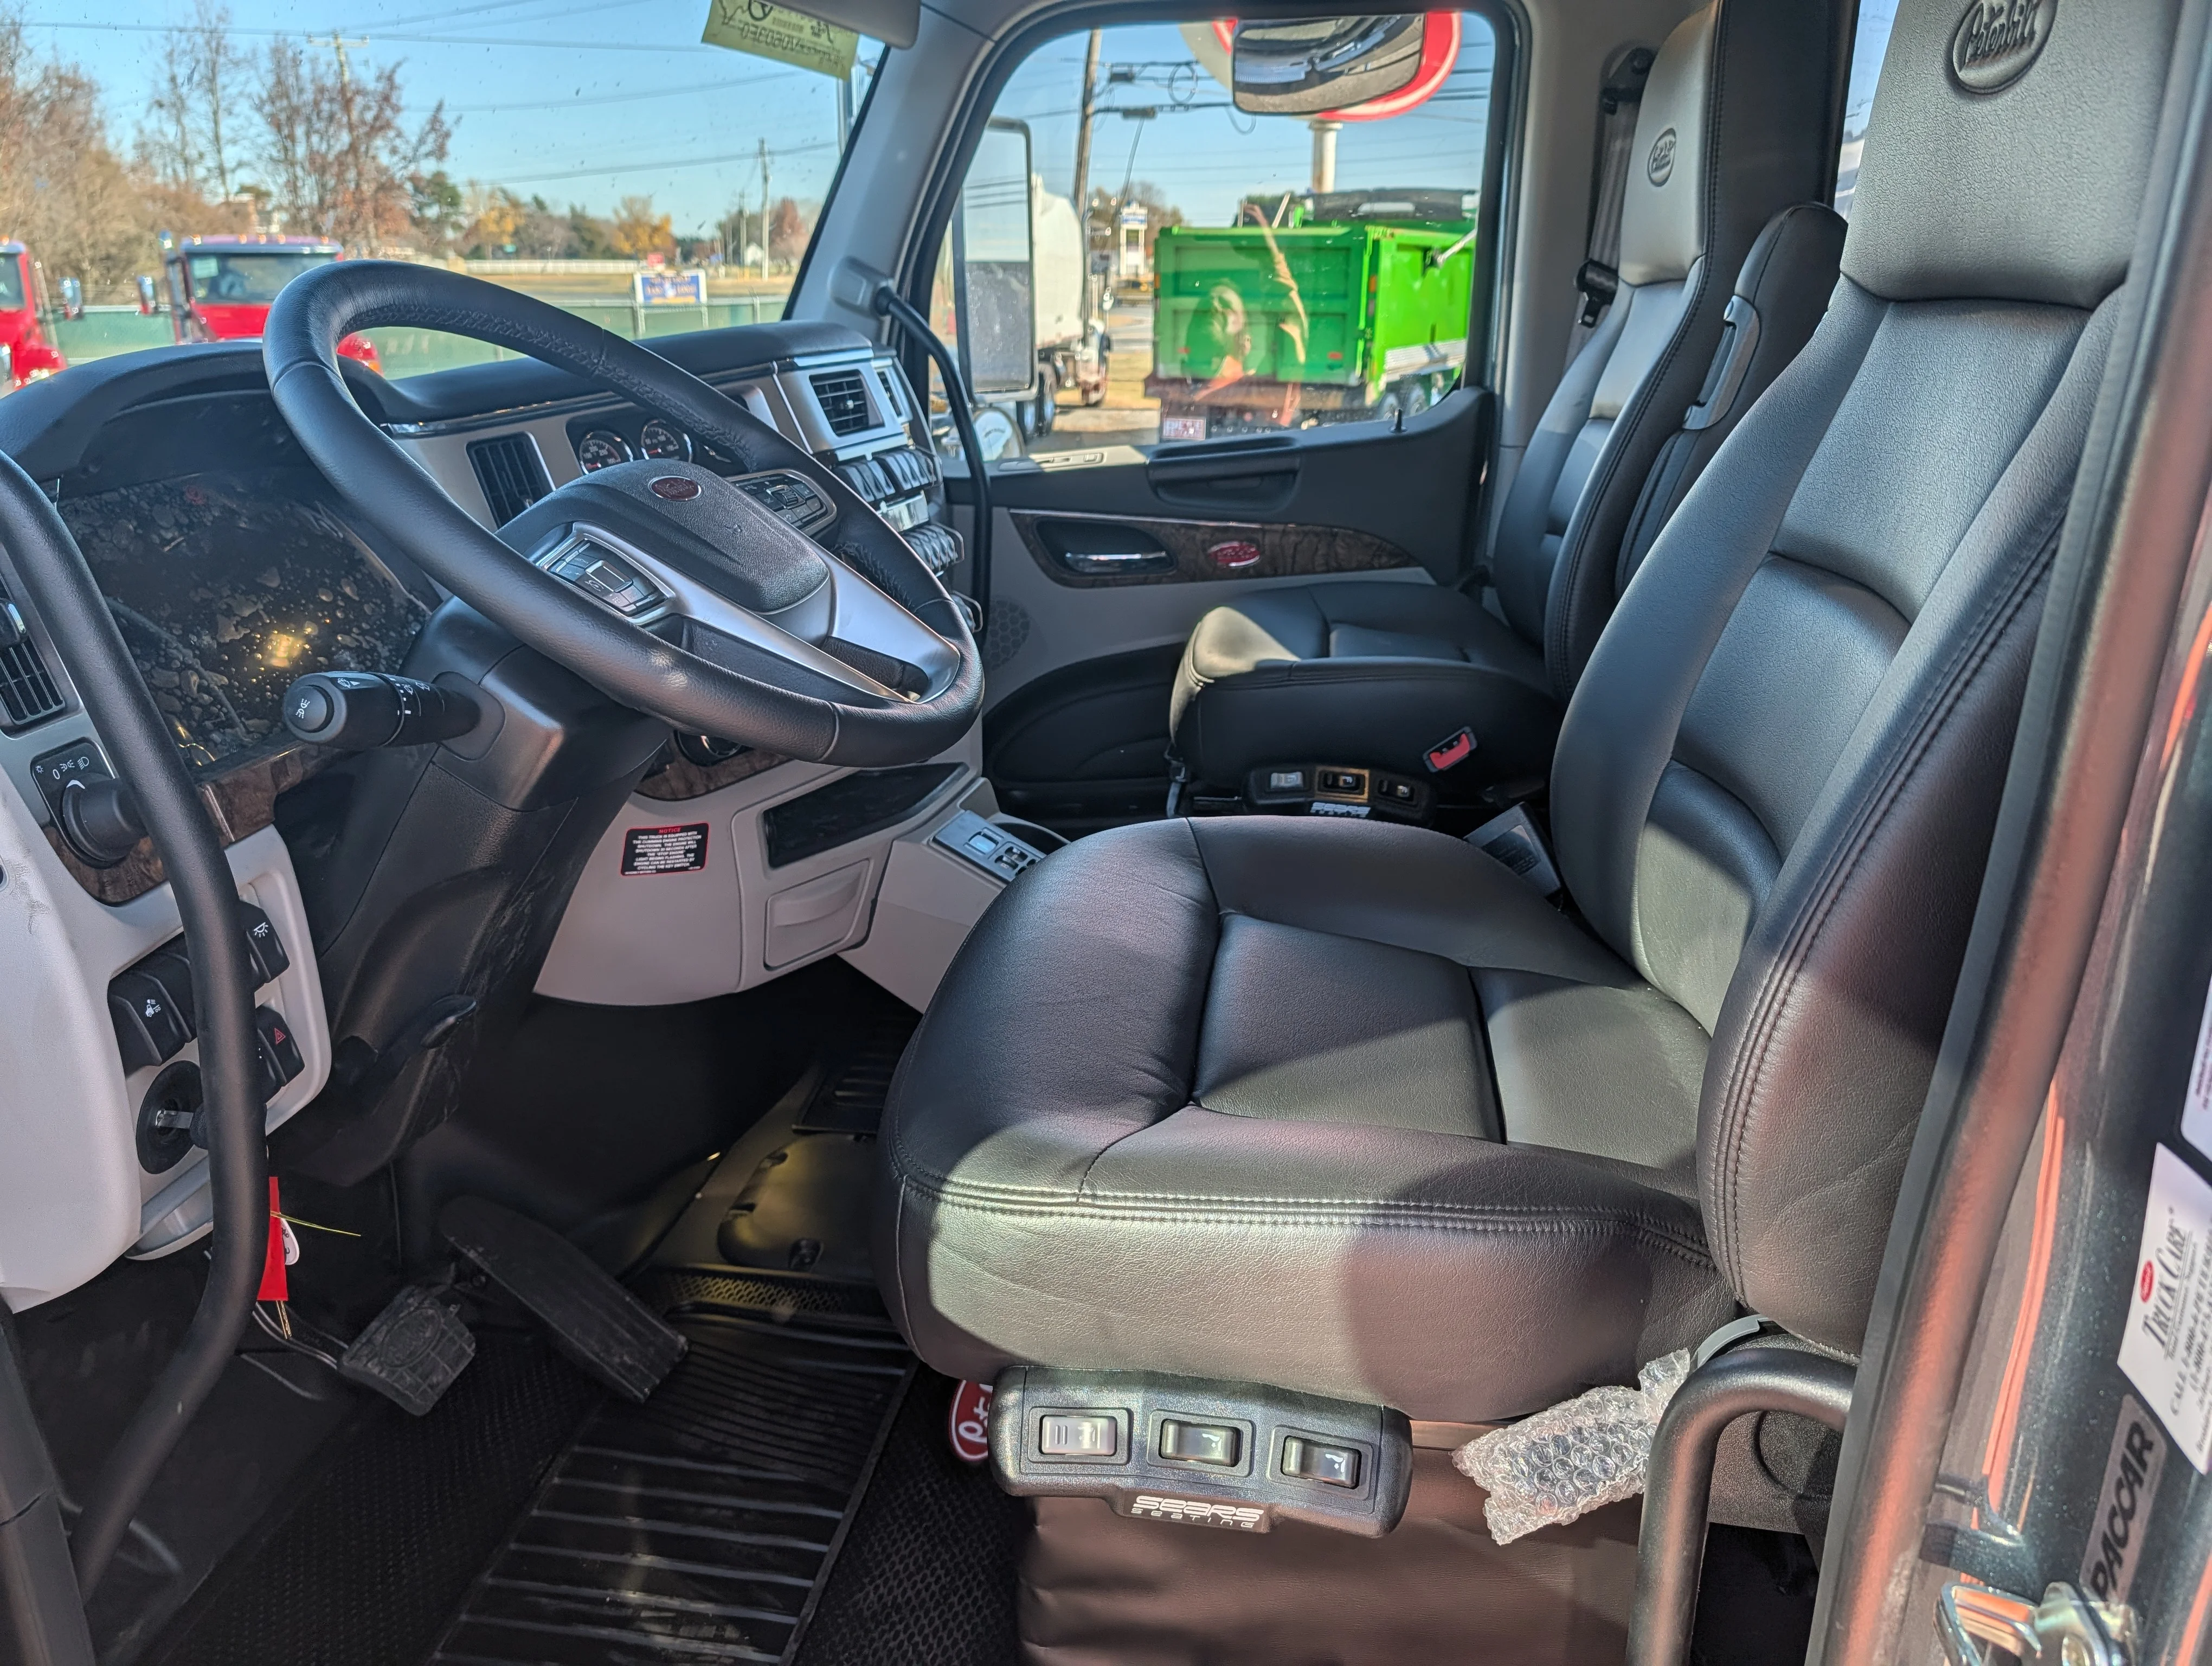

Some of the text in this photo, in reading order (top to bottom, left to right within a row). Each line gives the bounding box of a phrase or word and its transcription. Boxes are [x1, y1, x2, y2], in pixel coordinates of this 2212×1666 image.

[2142, 1219, 2185, 1348] TRUCK CARE
[2170, 1370, 2186, 1416] CALL
[2091, 1421, 2155, 1601] PACCAR
